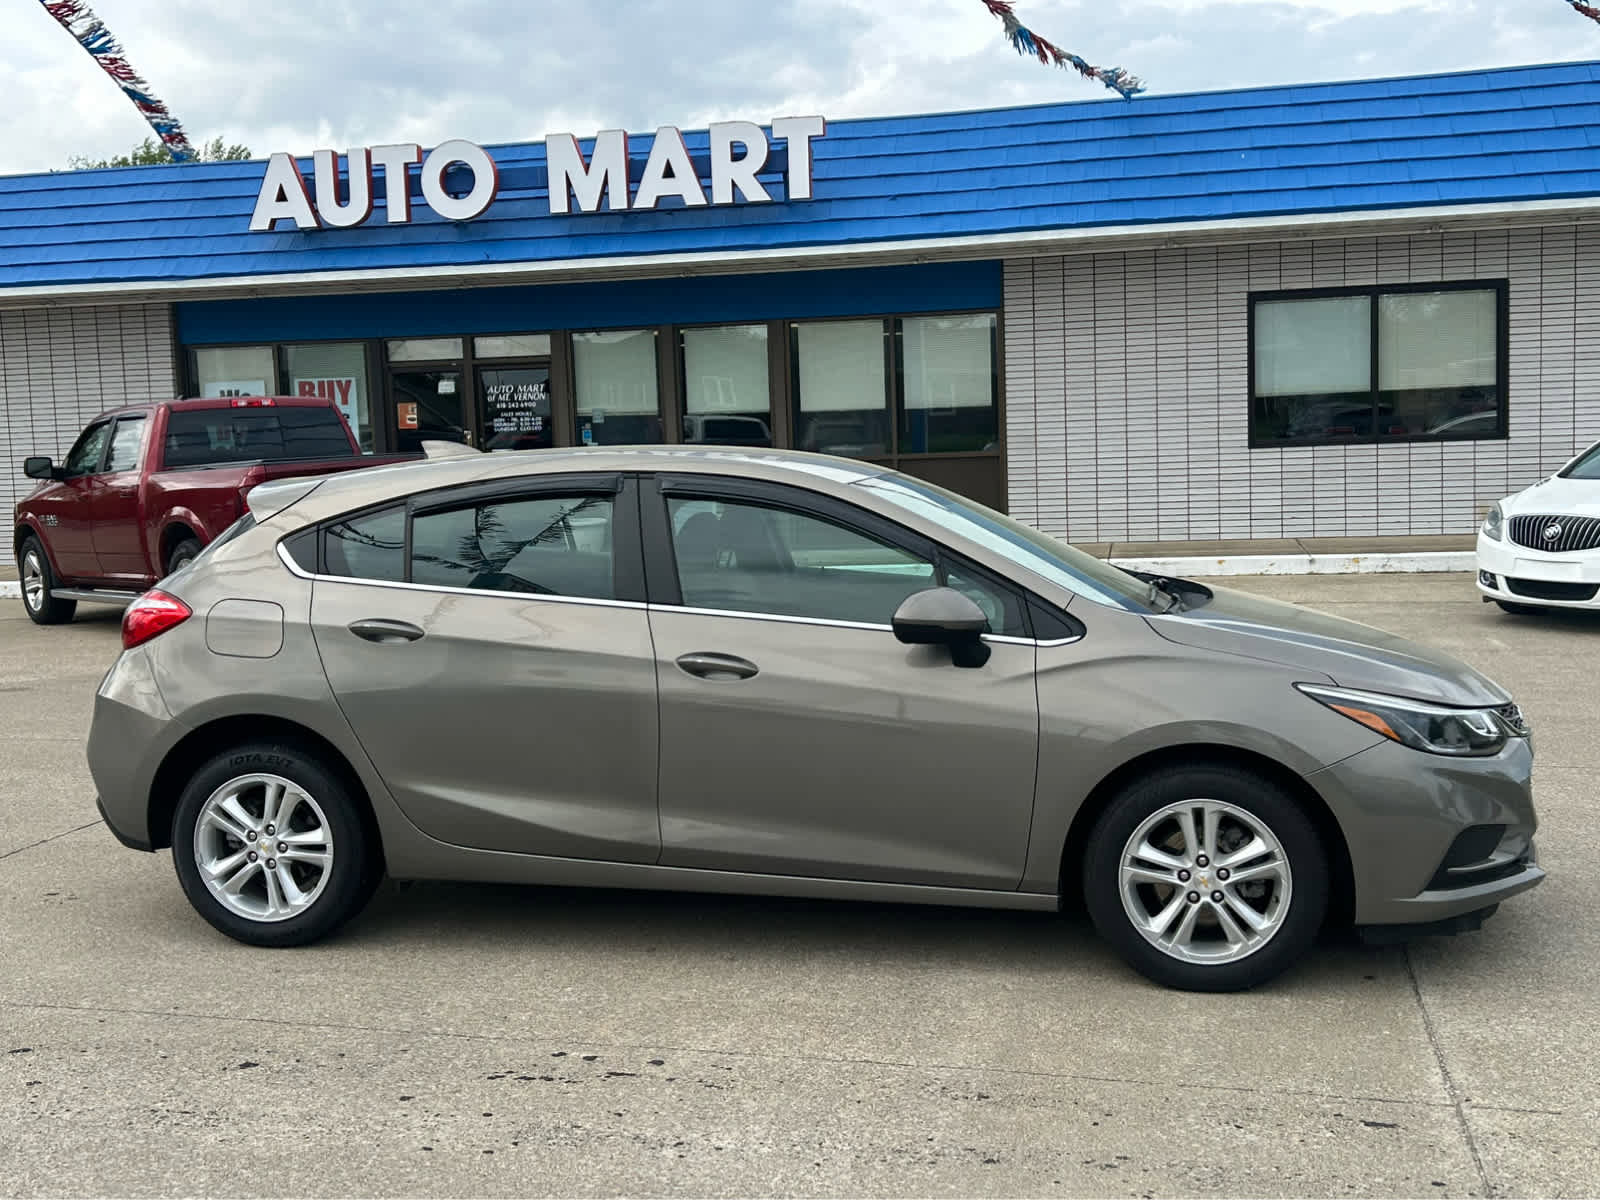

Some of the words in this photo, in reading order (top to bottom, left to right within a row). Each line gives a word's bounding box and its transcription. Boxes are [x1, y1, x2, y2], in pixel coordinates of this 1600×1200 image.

[248, 140, 498, 231] AUTO
[545, 115, 825, 214] MART
[298, 380, 351, 405] BUY
[487, 384, 514, 394] AUTO
[517, 383, 545, 393] MART
[513, 392, 546, 401] VERNON
